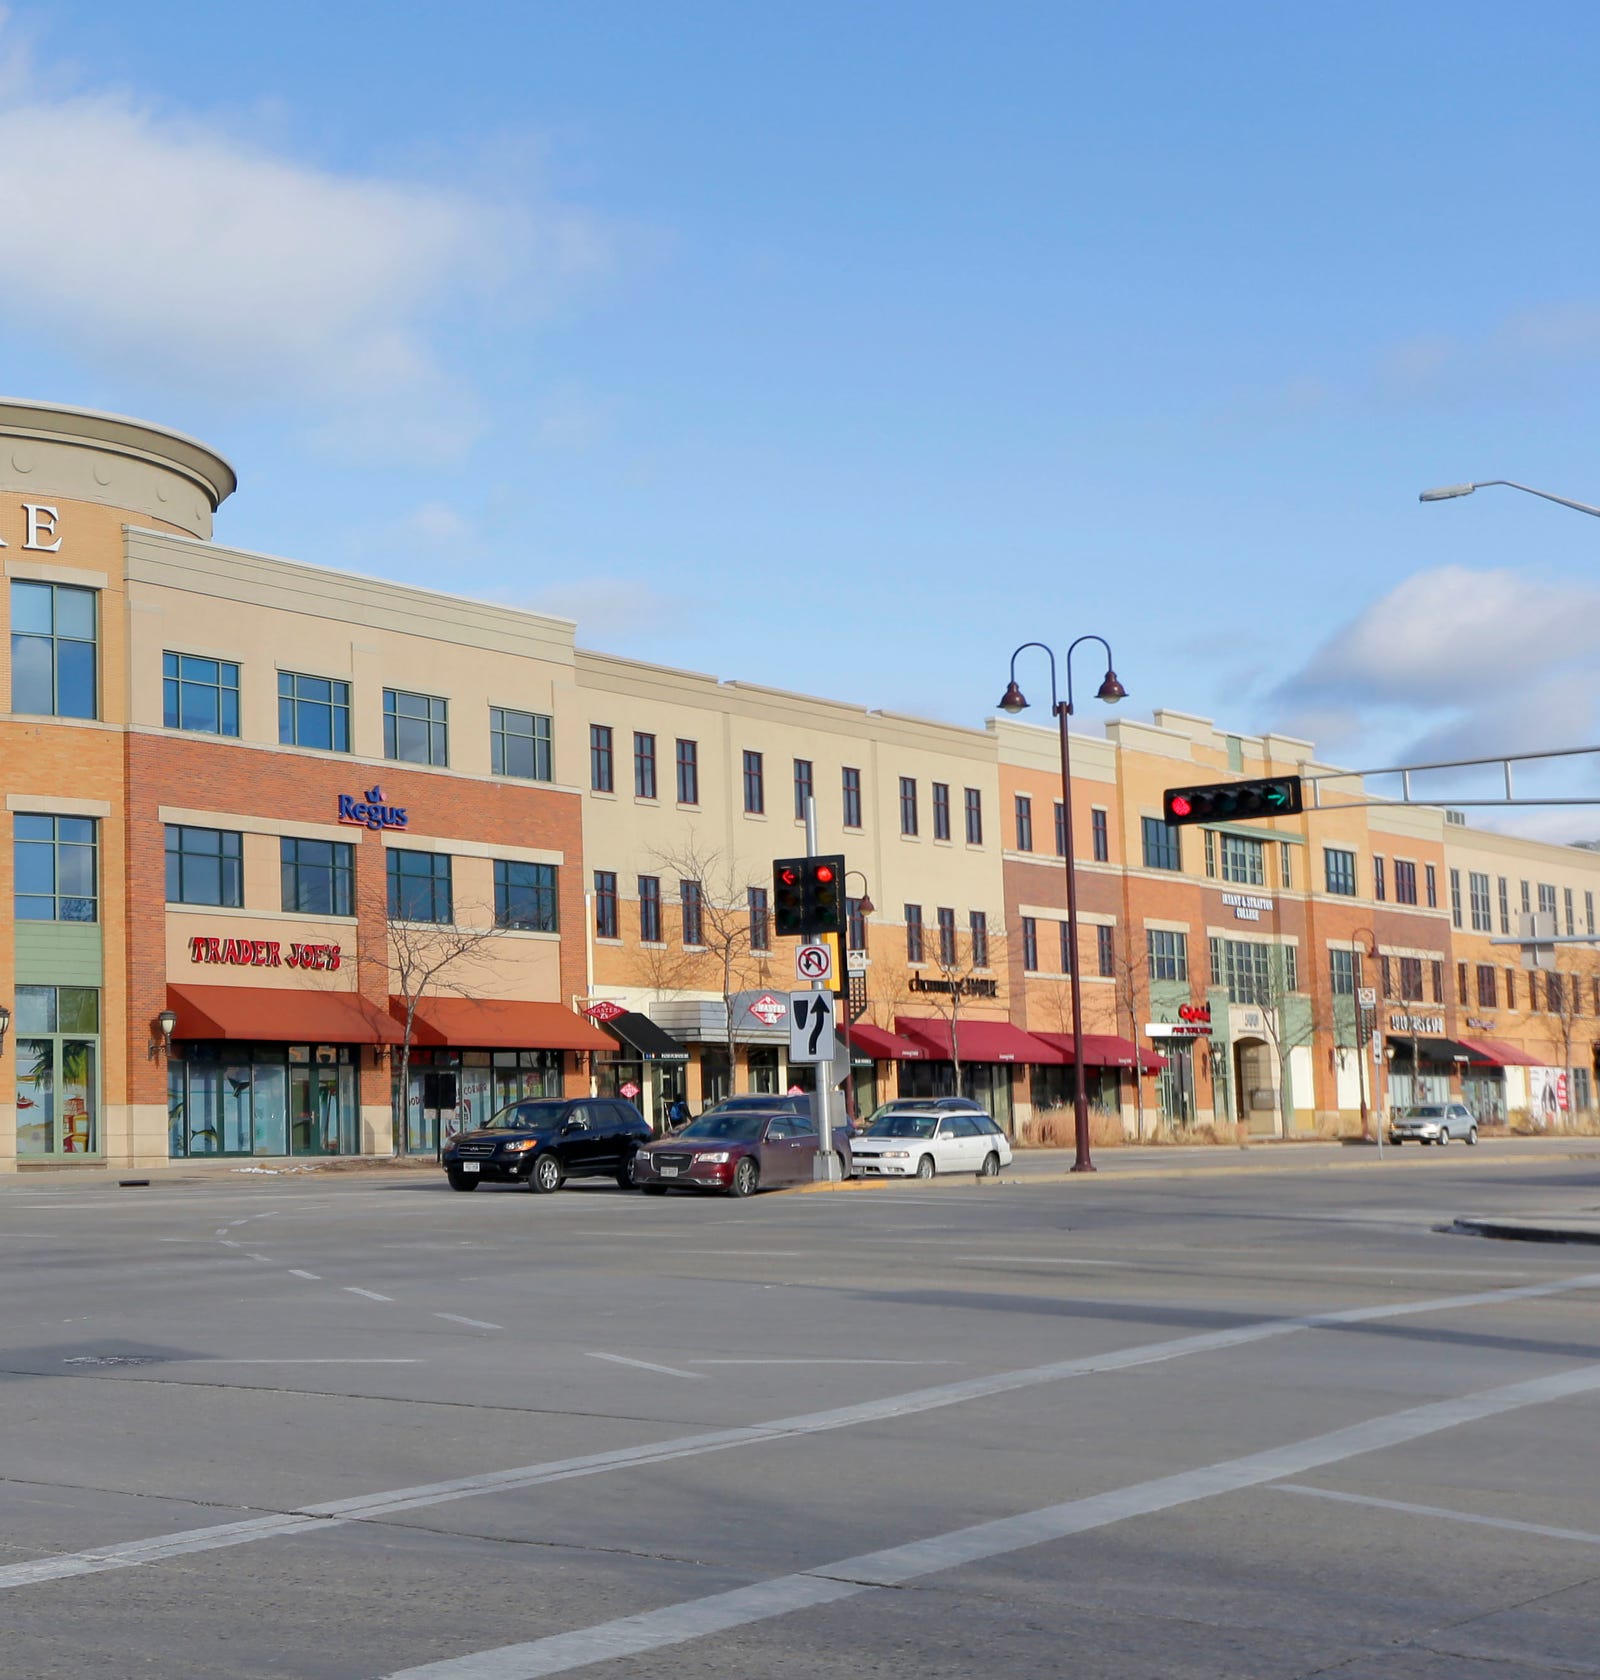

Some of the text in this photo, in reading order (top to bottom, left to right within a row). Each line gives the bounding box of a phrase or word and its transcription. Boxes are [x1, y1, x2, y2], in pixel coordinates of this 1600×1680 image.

[338, 794, 409, 830] Regus
[190, 937, 342, 971] TRADER JOE'S
